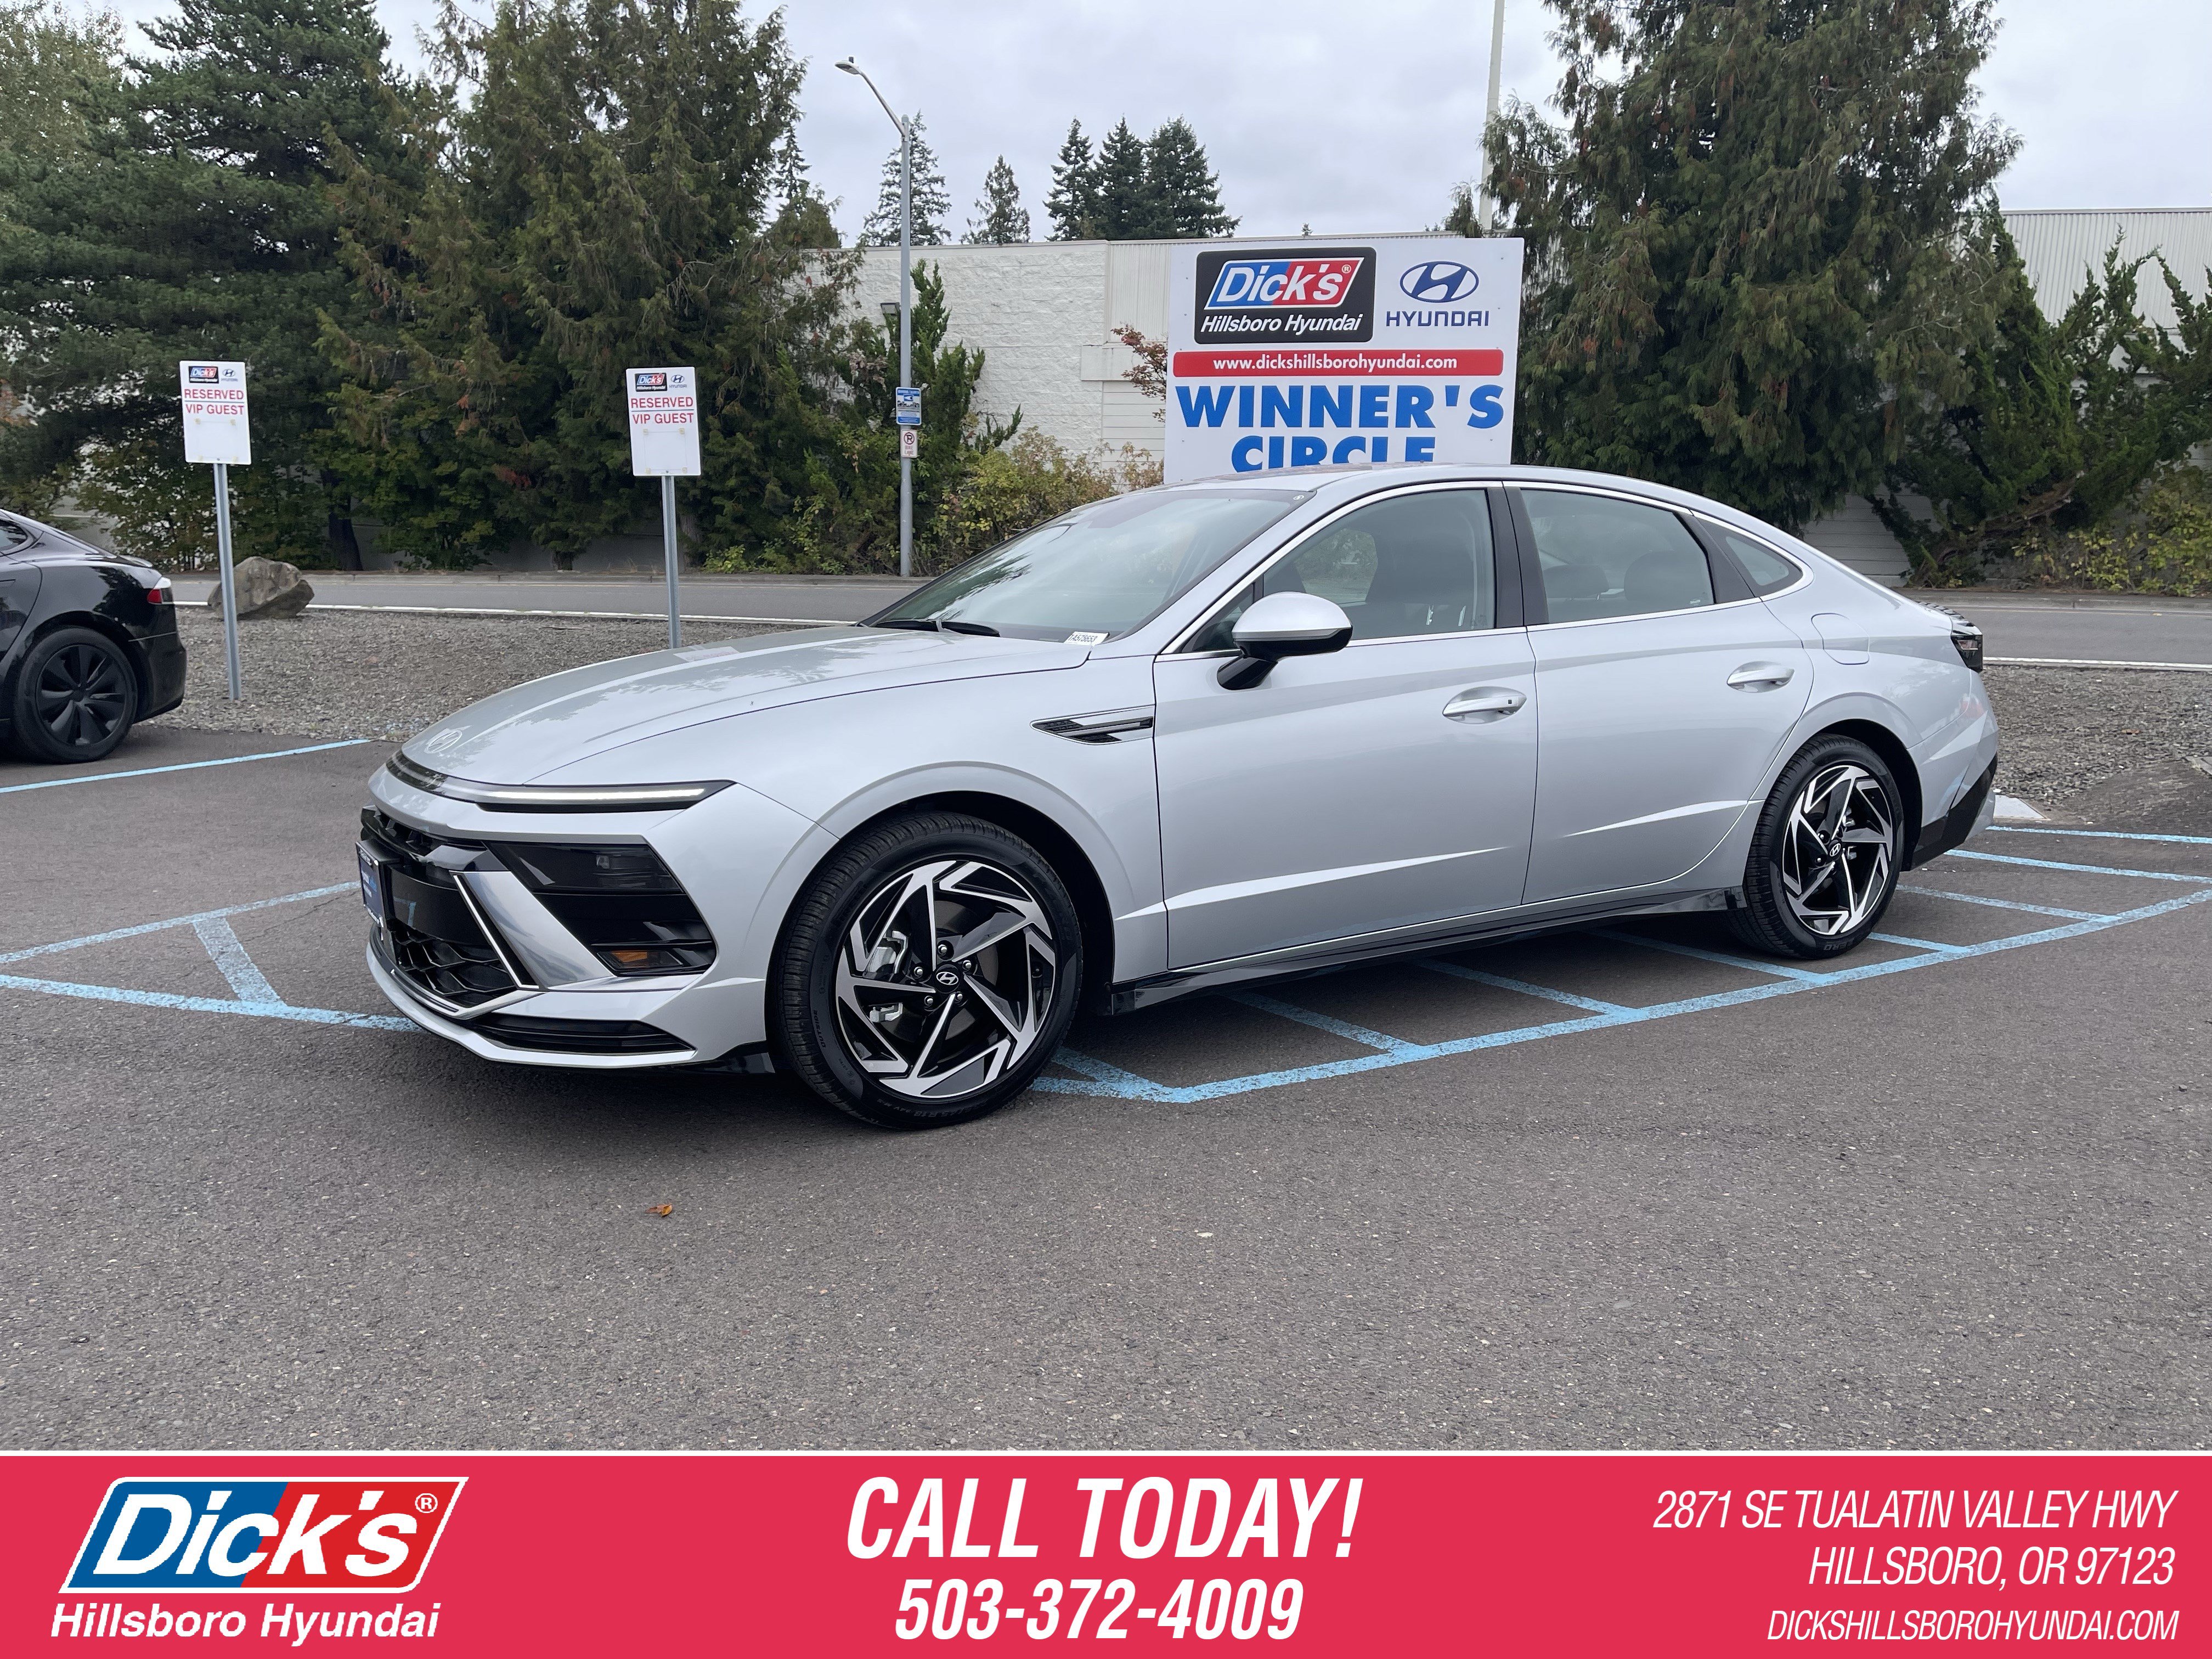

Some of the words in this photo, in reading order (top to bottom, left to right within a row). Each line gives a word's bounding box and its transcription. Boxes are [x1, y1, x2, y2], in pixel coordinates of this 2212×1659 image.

[1217, 263, 1342, 302] Dick's
[1200, 315, 1280, 332] Hillsboro
[1284, 313, 1363, 335] Hyundai
[1386, 311, 1489, 326] HYUNDAI
[1213, 353, 1457, 373] www.dickshillsborohyundai.com
[184, 388, 244, 400] RESERVED
[185, 404, 203, 414] VIP
[207, 404, 245, 415] GUEST
[631, 397, 693, 408] RESERVED
[1175, 385, 1504, 429] WINNER'S
[633, 414, 651, 424] VIP
[654, 413, 694, 424] GUEST
